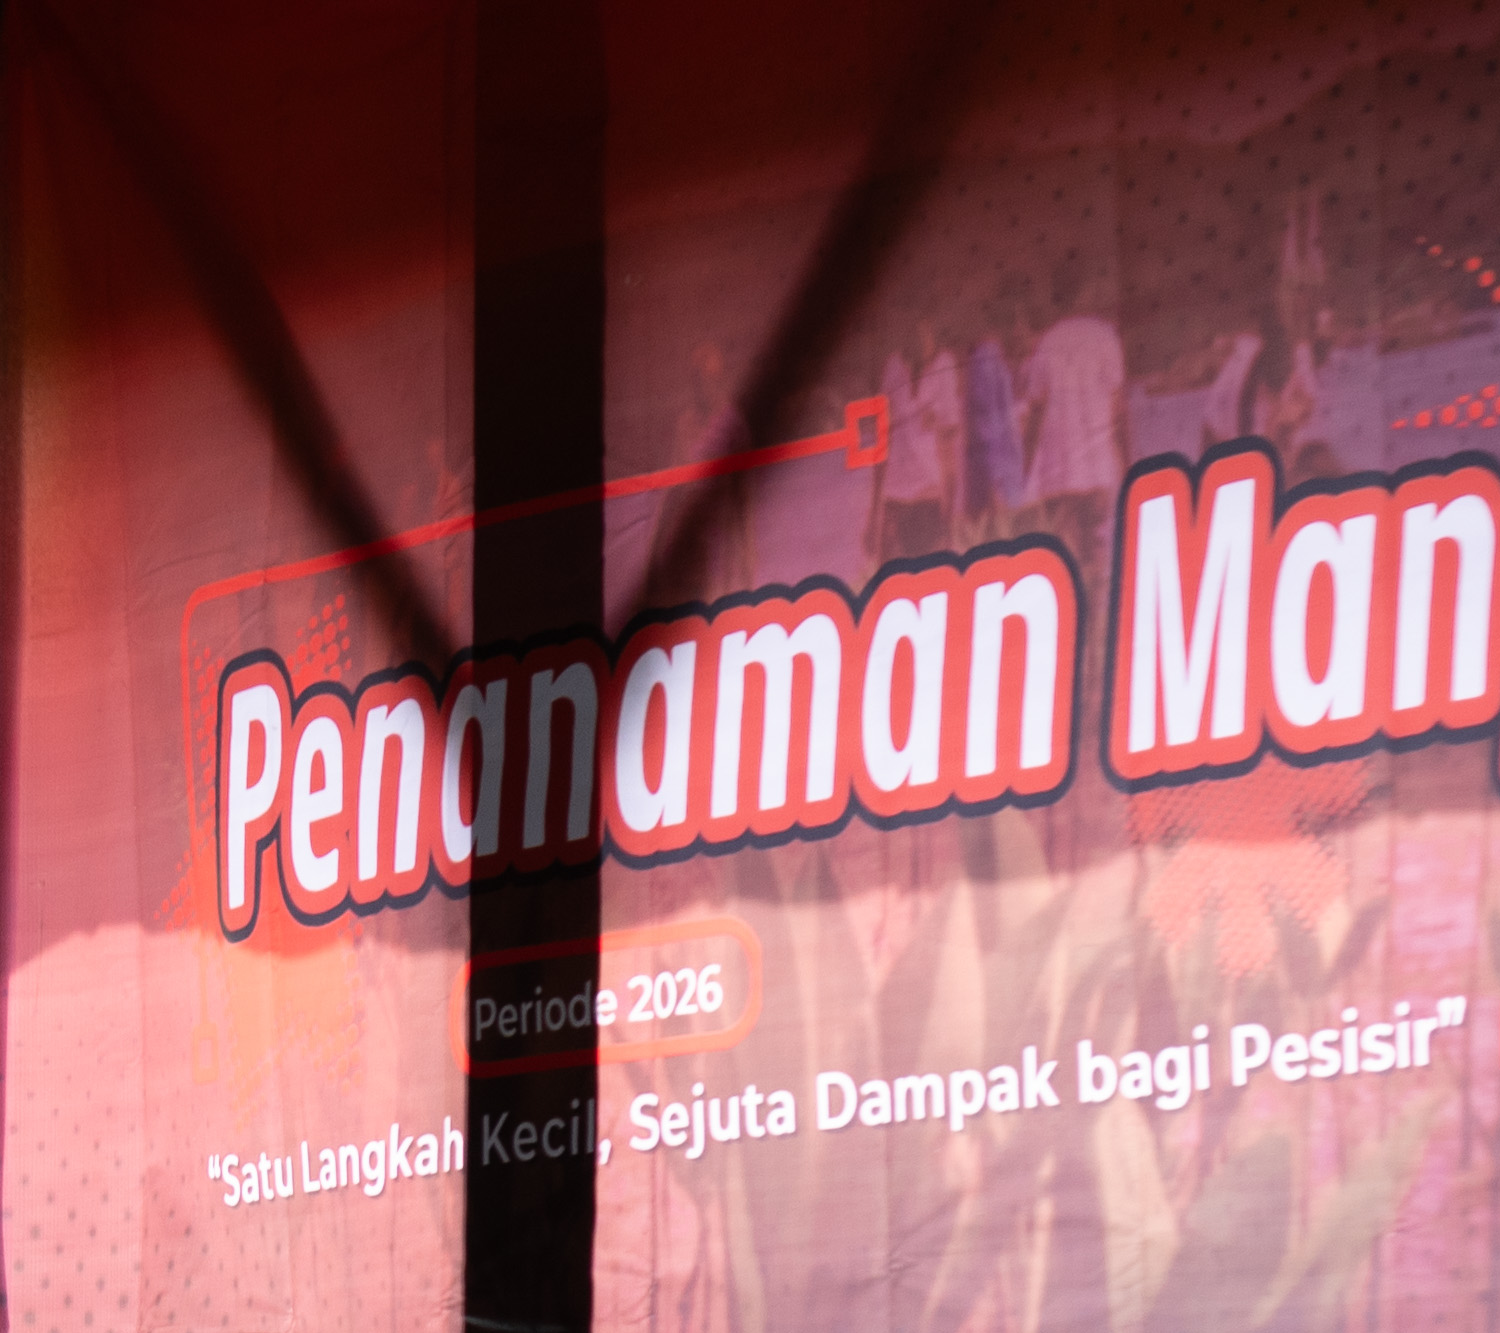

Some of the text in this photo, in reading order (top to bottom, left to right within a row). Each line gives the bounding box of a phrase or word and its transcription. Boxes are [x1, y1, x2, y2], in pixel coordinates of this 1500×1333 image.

[226, 571, 1059, 910] Penanaman
[208, 996, 1467, 1208] “Satu Langkah Kecil, Sejuta Dampak bagi Pesisir”
[474, 963, 724, 1042] Periode 2026
